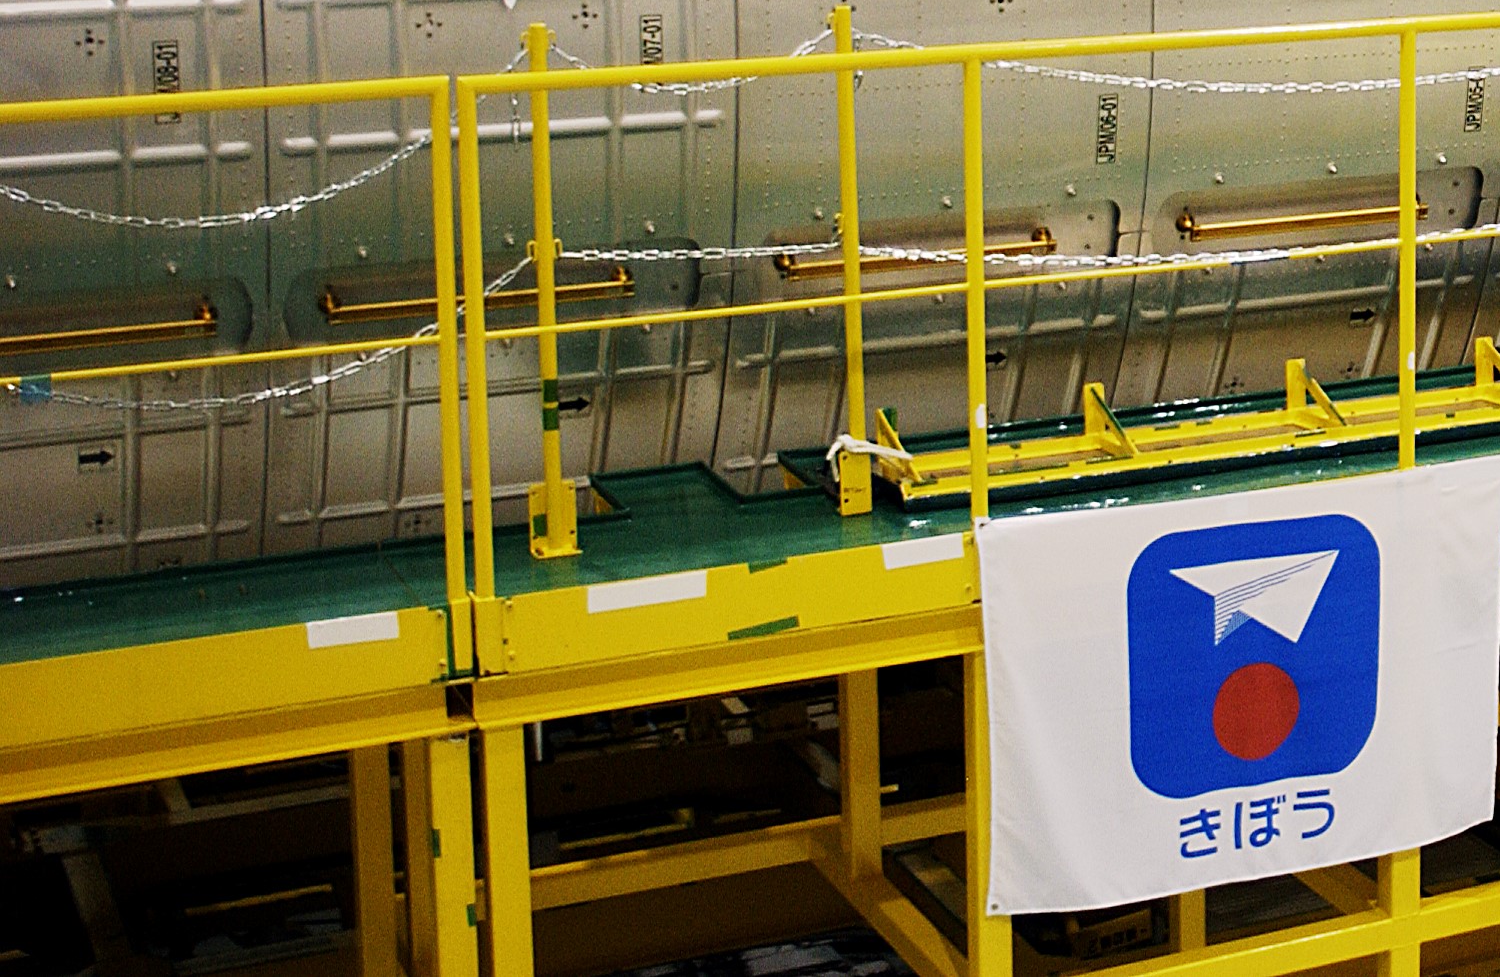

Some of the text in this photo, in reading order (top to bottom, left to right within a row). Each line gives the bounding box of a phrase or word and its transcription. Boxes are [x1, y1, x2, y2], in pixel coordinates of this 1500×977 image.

[155, 44, 178, 121] J/08-01
[1466, 71, 1483, 129] JPM/05-
[1180, 789, 1335, 858] きぼう
